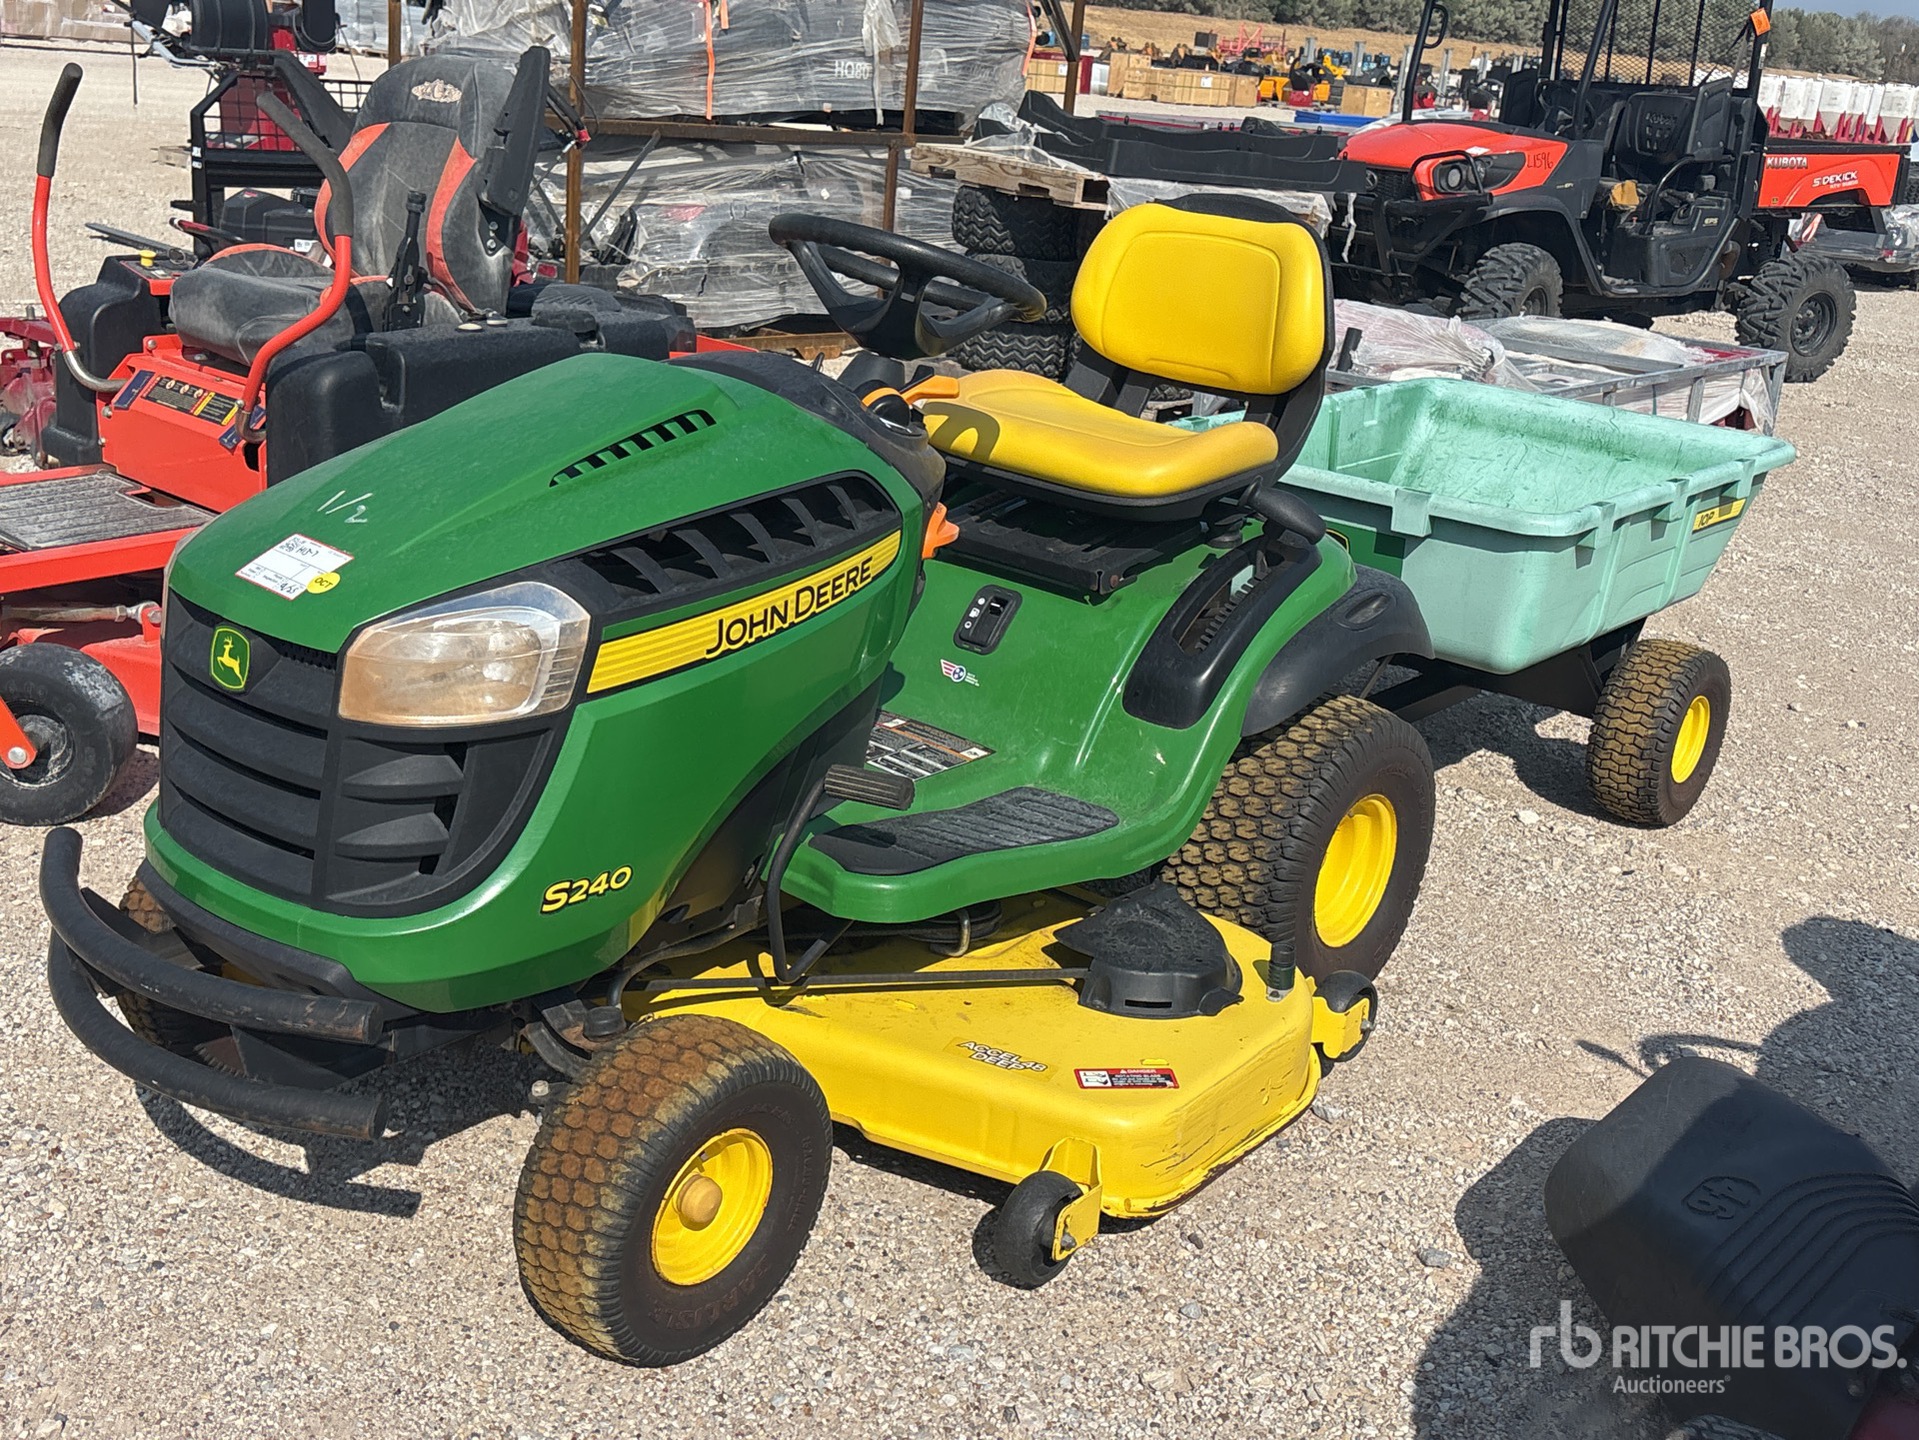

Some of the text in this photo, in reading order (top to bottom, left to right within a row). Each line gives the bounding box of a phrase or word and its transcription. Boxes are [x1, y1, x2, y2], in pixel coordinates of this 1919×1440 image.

[1526, 151, 1554, 170] L1596
[1766, 156, 1808, 169] KUBOTA
[316, 489, 374, 524] 1/2
[314, 576, 334, 589] OCT
[705, 555, 873, 656] JOHN DEERE
[541, 865, 633, 913] S240
[957, 1040, 1049, 1073] ACCEL 48
[969, 1051, 1025, 1071] DEEP
